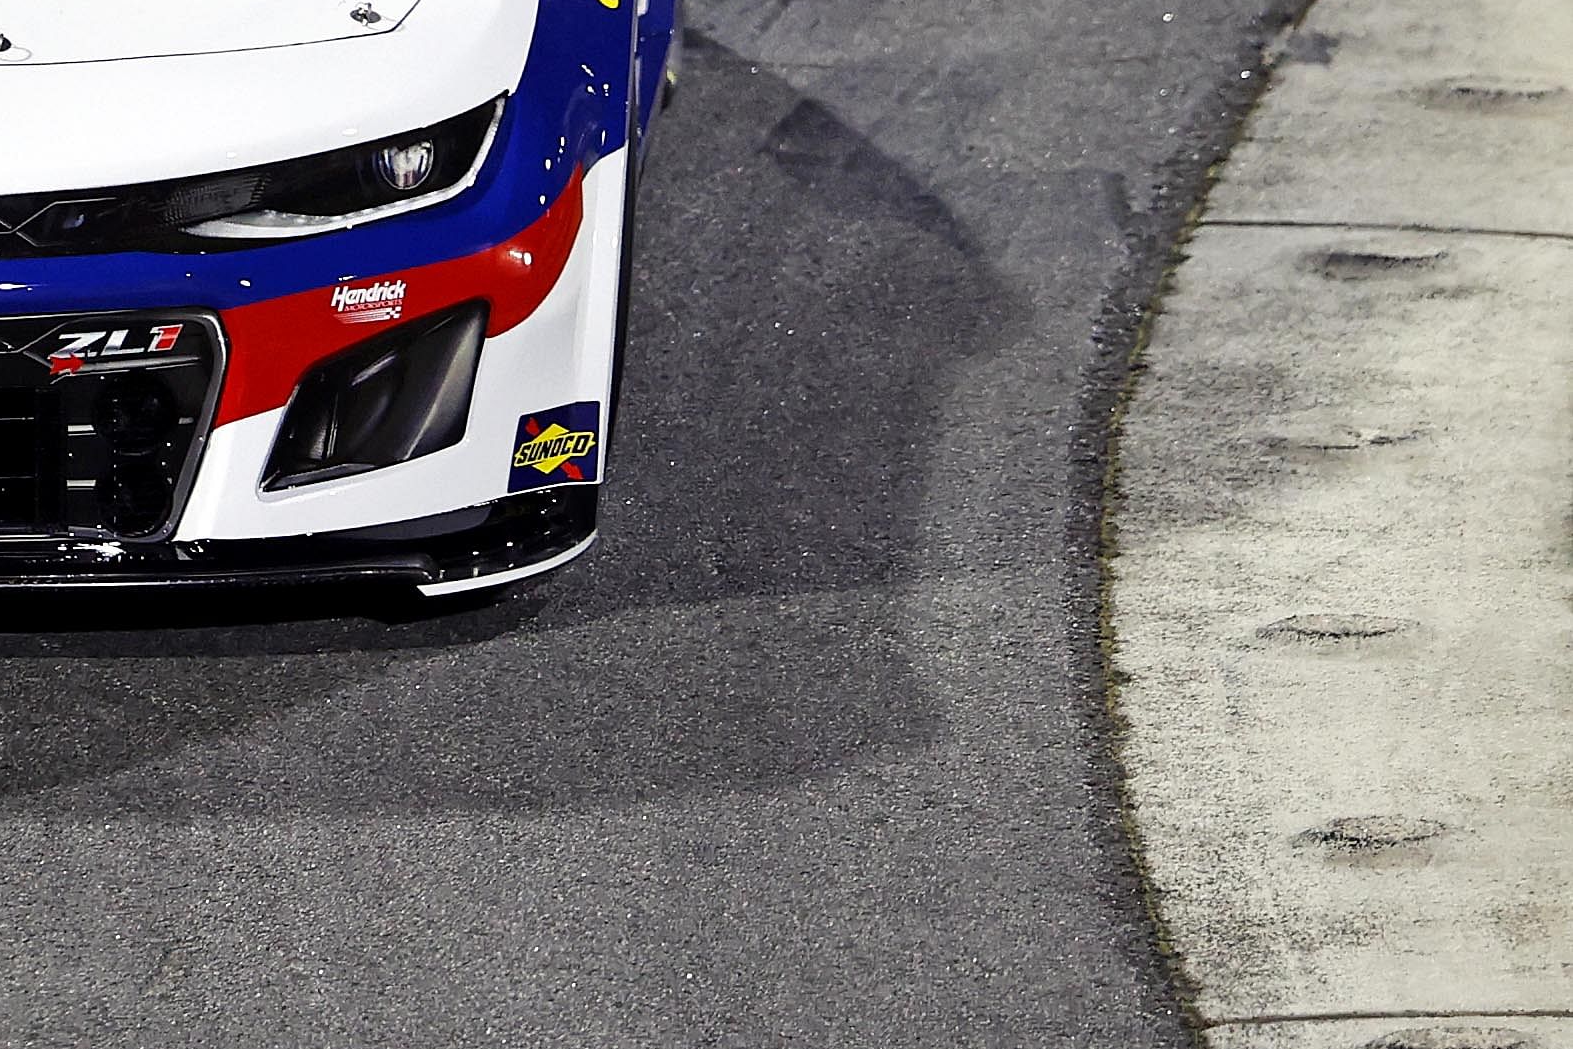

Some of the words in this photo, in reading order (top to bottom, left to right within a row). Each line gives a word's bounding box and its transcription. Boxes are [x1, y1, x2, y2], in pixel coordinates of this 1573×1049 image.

[330, 279, 407, 312] Hendrick
[47, 323, 184, 360] ZL1
[515, 434, 592, 463] SUNOCO
